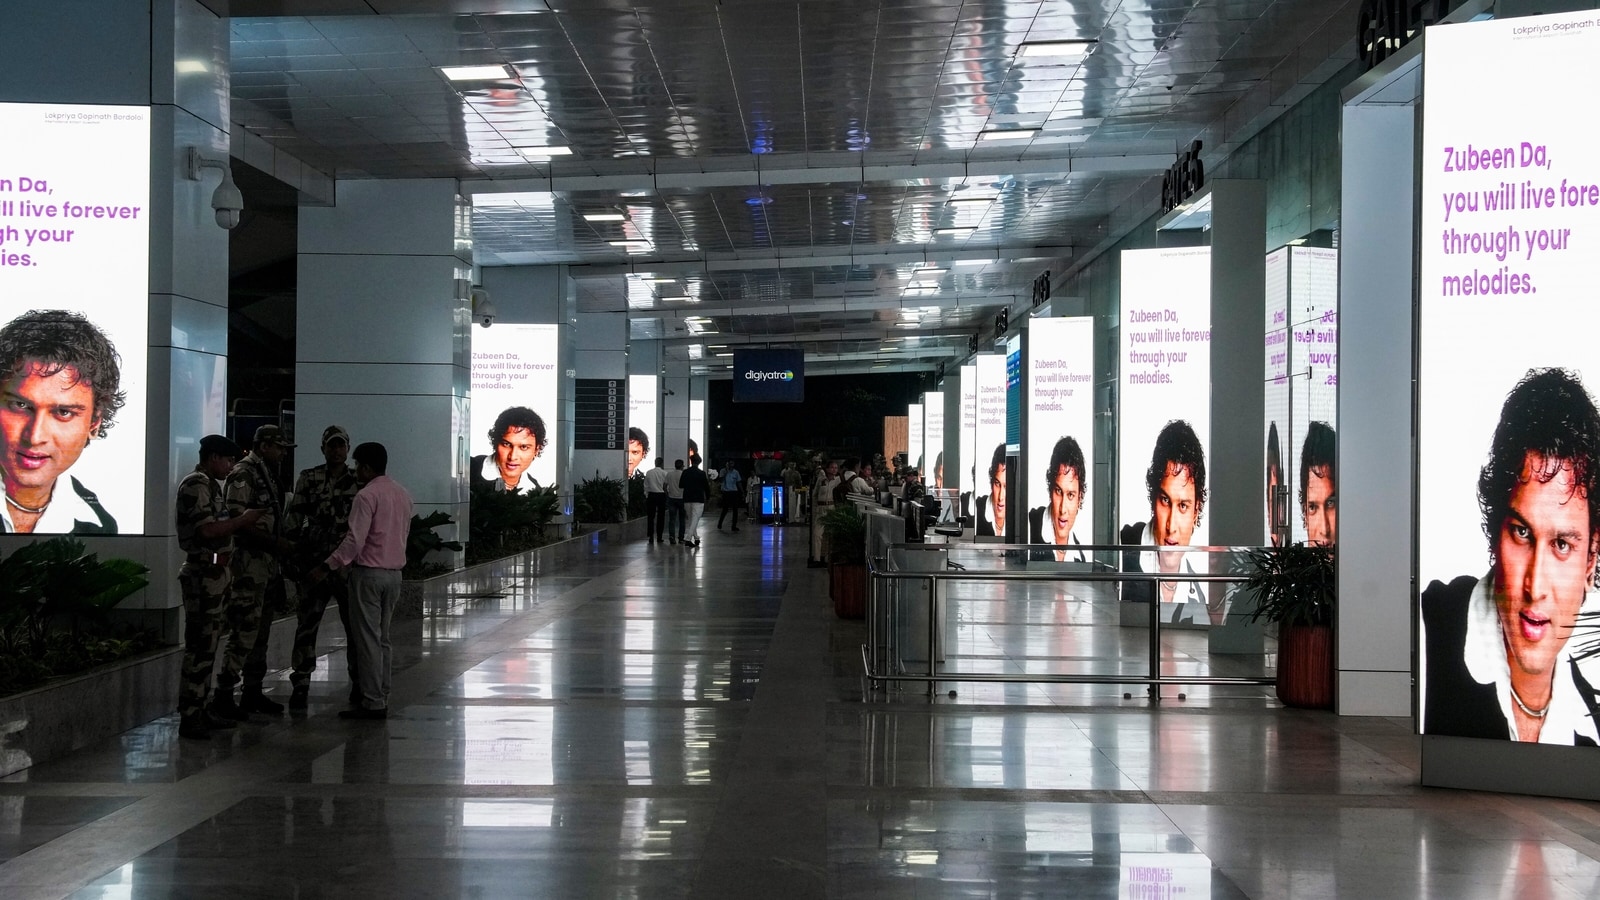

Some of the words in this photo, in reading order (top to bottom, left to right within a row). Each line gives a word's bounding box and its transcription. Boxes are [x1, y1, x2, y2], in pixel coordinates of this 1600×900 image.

[1513, 25, 1550, 35] Lokpriya
[1552, 20, 1594, 32] Gopinath
[45, 113, 76, 121] Lokpriya
[1444, 144, 1514, 172] Zubeen
[1521, 142, 1551, 170] Da,
[19, 177, 52, 195] Da,
[1443, 192, 1478, 222] you
[1484, 182, 1515, 211] will
[1521, 180, 1555, 209] live
[20, 200, 57, 217] live
[63, 202, 140, 218] forever
[25, 229, 74, 246] your
[1443, 226, 1520, 261] through
[1525, 229, 1570, 260] your
[1443, 266, 1536, 296] melodies.
[1130, 310, 1162, 323] Zubeen
[1164, 309, 1178, 323] Da,
[1130, 333, 1146, 347] you
[1148, 329, 1162, 342] will
[1165, 328, 1180, 342] live
[1035, 360, 1057, 368] Zubeen
[1058, 360, 1067, 369] Da,
[1130, 350, 1164, 367] through
[1167, 352, 1187, 367] your
[472, 372, 506, 381] through
[745, 370, 787, 381] digiyatra
[1035, 376, 1046, 385] you
[1047, 373, 1057, 382] will
[1058, 373, 1069, 382] live
[1070, 373, 1091, 382] forever
[1130, 370, 1172, 384] melodies.
[1035, 388, 1058, 400] through
[1060, 390, 1073, 399] your
[1035, 401, 1063, 411] melodies.
